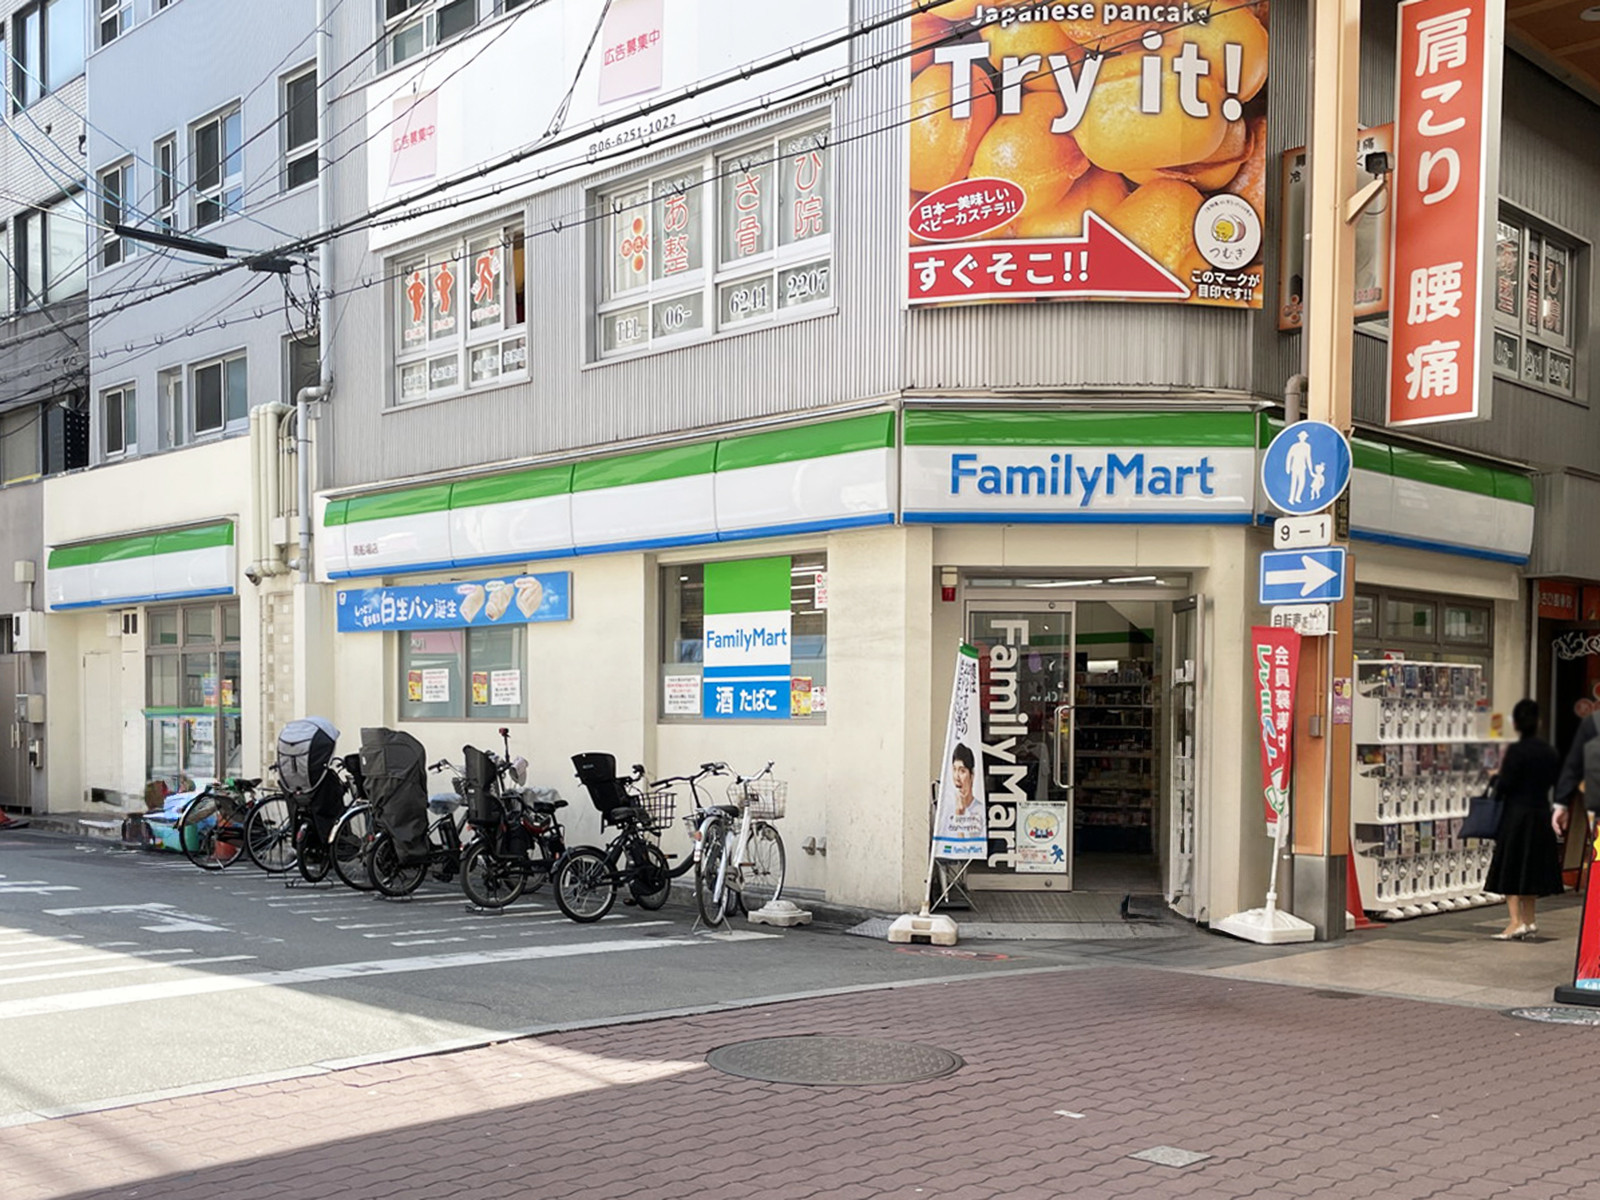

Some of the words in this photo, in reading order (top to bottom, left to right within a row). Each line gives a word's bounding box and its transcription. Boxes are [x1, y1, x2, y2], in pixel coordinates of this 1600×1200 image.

[970, 3, 1095, 27] Japanese
[603, 29, 660, 66] 広告募集中
[934, 41, 1104, 134] Try
[1141, 30, 1243, 122] it!
[1415, 8, 1471, 205] 肩こり
[920, 188, 1010, 219] 日本一美味しい
[913, 250, 1089, 292] すぐそこ!!
[1209, 247, 1246, 261] つむぎ
[1191, 269, 1260, 287] このマークが
[1198, 284, 1252, 300] 目印です!!
[616, 318, 640, 341] TEL
[730, 284, 767, 313] 6241
[786, 268, 829, 298] 2207
[1405, 261, 1464, 400] 腰痛
[950, 453, 1215, 507] FamilyMart
[706, 627, 787, 652] FamilyMart
[715, 686, 735, 713] 酒
[739, 688, 777, 711] たばこ
[981, 619, 1029, 868] FamilyMart
